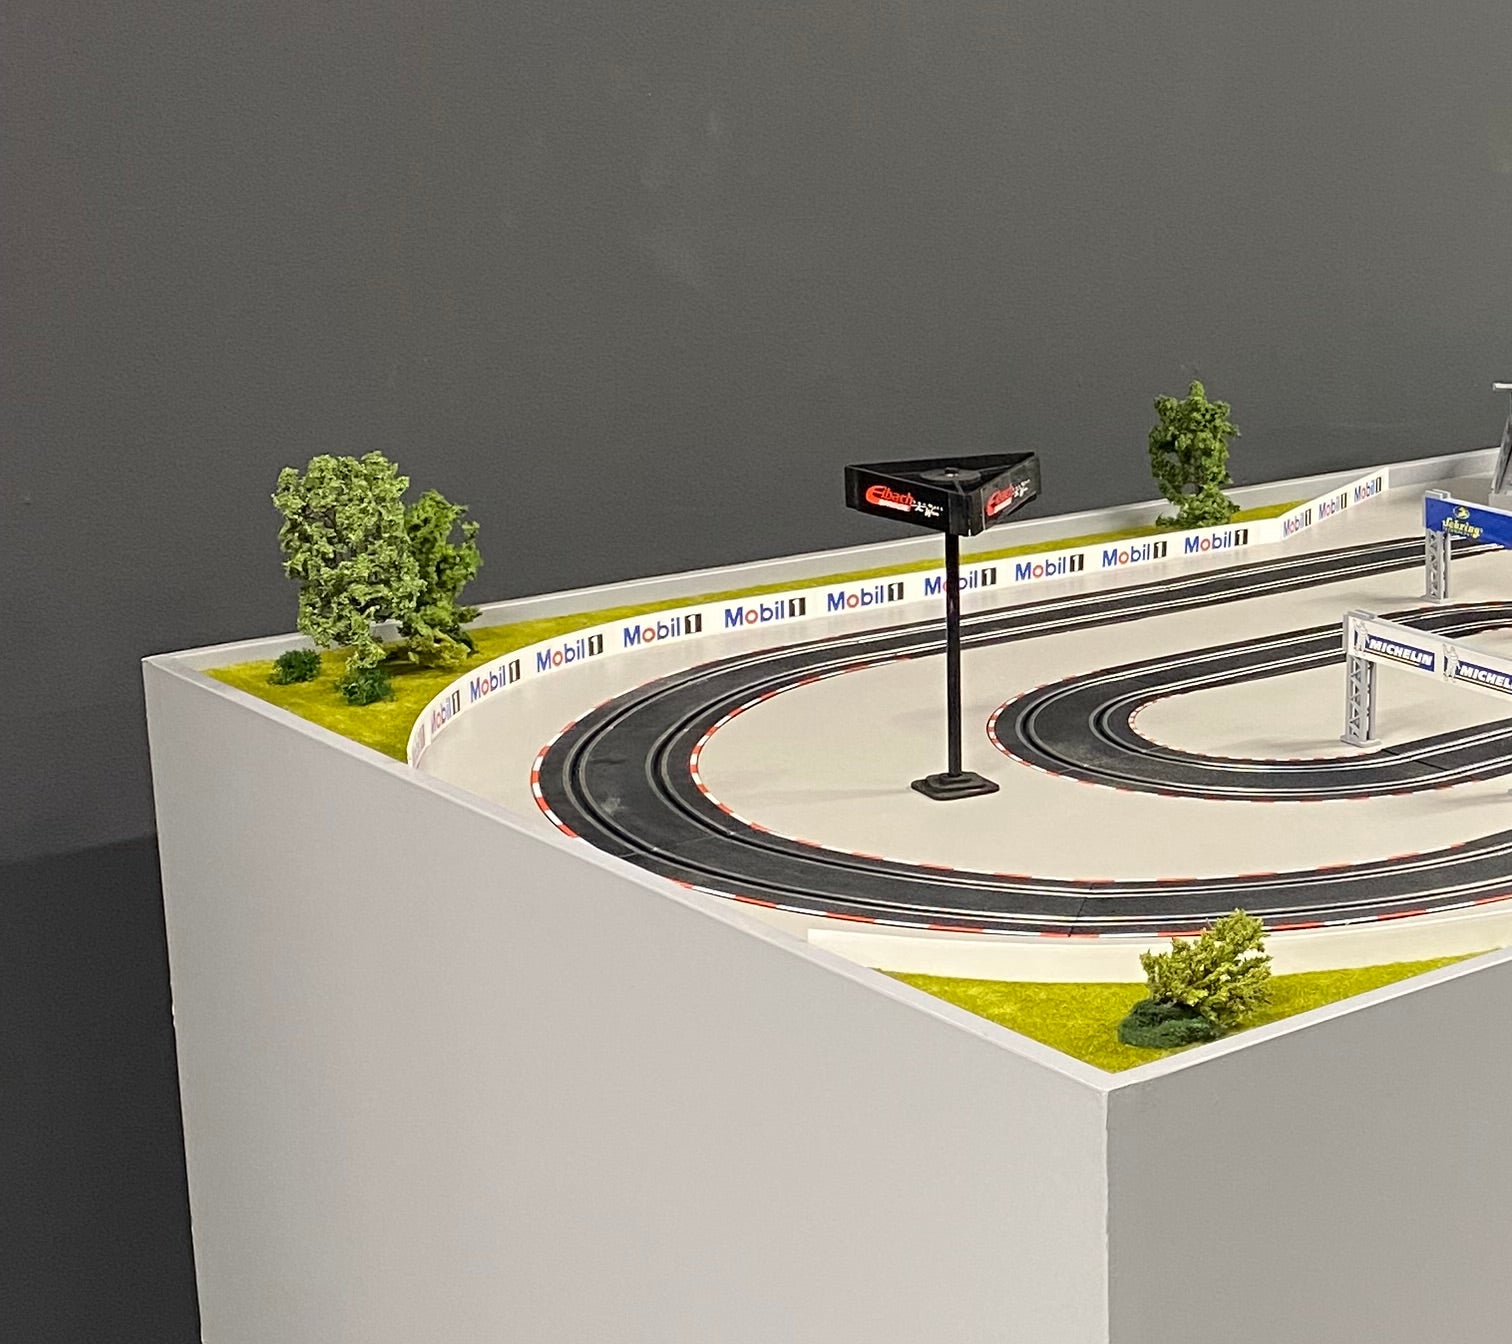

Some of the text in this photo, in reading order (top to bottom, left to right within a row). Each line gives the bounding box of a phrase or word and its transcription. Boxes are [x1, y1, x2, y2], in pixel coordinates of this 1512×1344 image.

[866, 485, 914, 506] Eibach
[1354, 479, 1375, 503] Mobil
[1318, 496, 1340, 520] Mobil
[1184, 528, 1249, 555] Mobil 1
[1442, 517, 1483, 539] Sebring
[1015, 554, 1085, 581] Mobil 1
[1102, 541, 1167, 568] Mobil 1
[981, 567, 997, 587] 1
[827, 582, 904, 612] Mobil 1
[724, 597, 806, 628] Mobil 1
[623, 613, 702, 648] Mobil 1
[536, 634, 603, 673] Mobil 1
[1368, 639, 1432, 667] MICHELIN
[470, 659, 521, 703] Mobil 1
